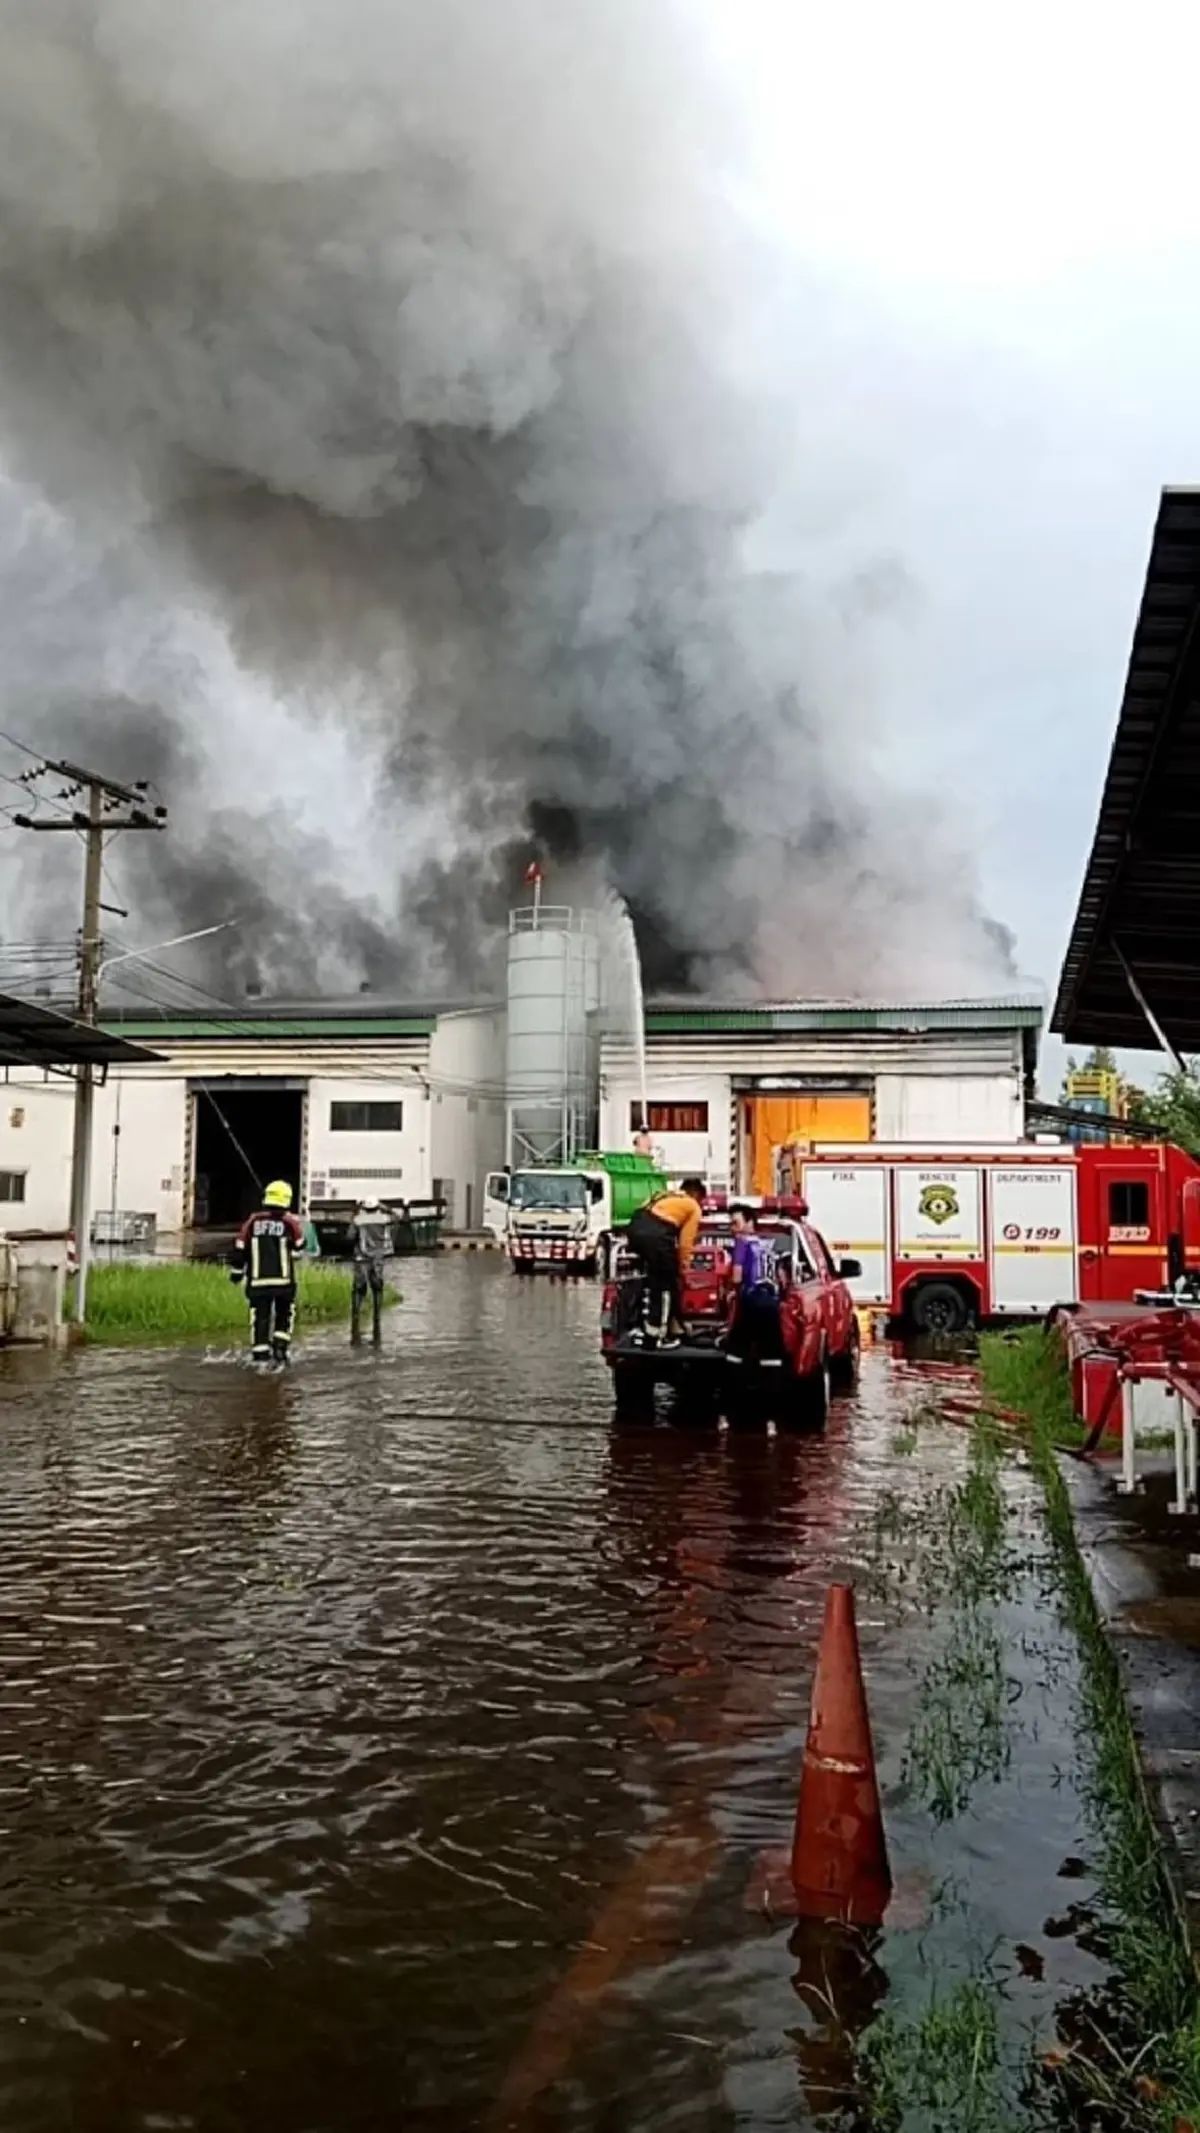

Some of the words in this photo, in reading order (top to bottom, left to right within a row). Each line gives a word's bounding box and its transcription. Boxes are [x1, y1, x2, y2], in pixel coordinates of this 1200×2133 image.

[997, 1173, 1061, 1183] DEPARTMENT
[253, 1220, 285, 1236] BFRD
[1024, 1227, 1061, 1239] 199
